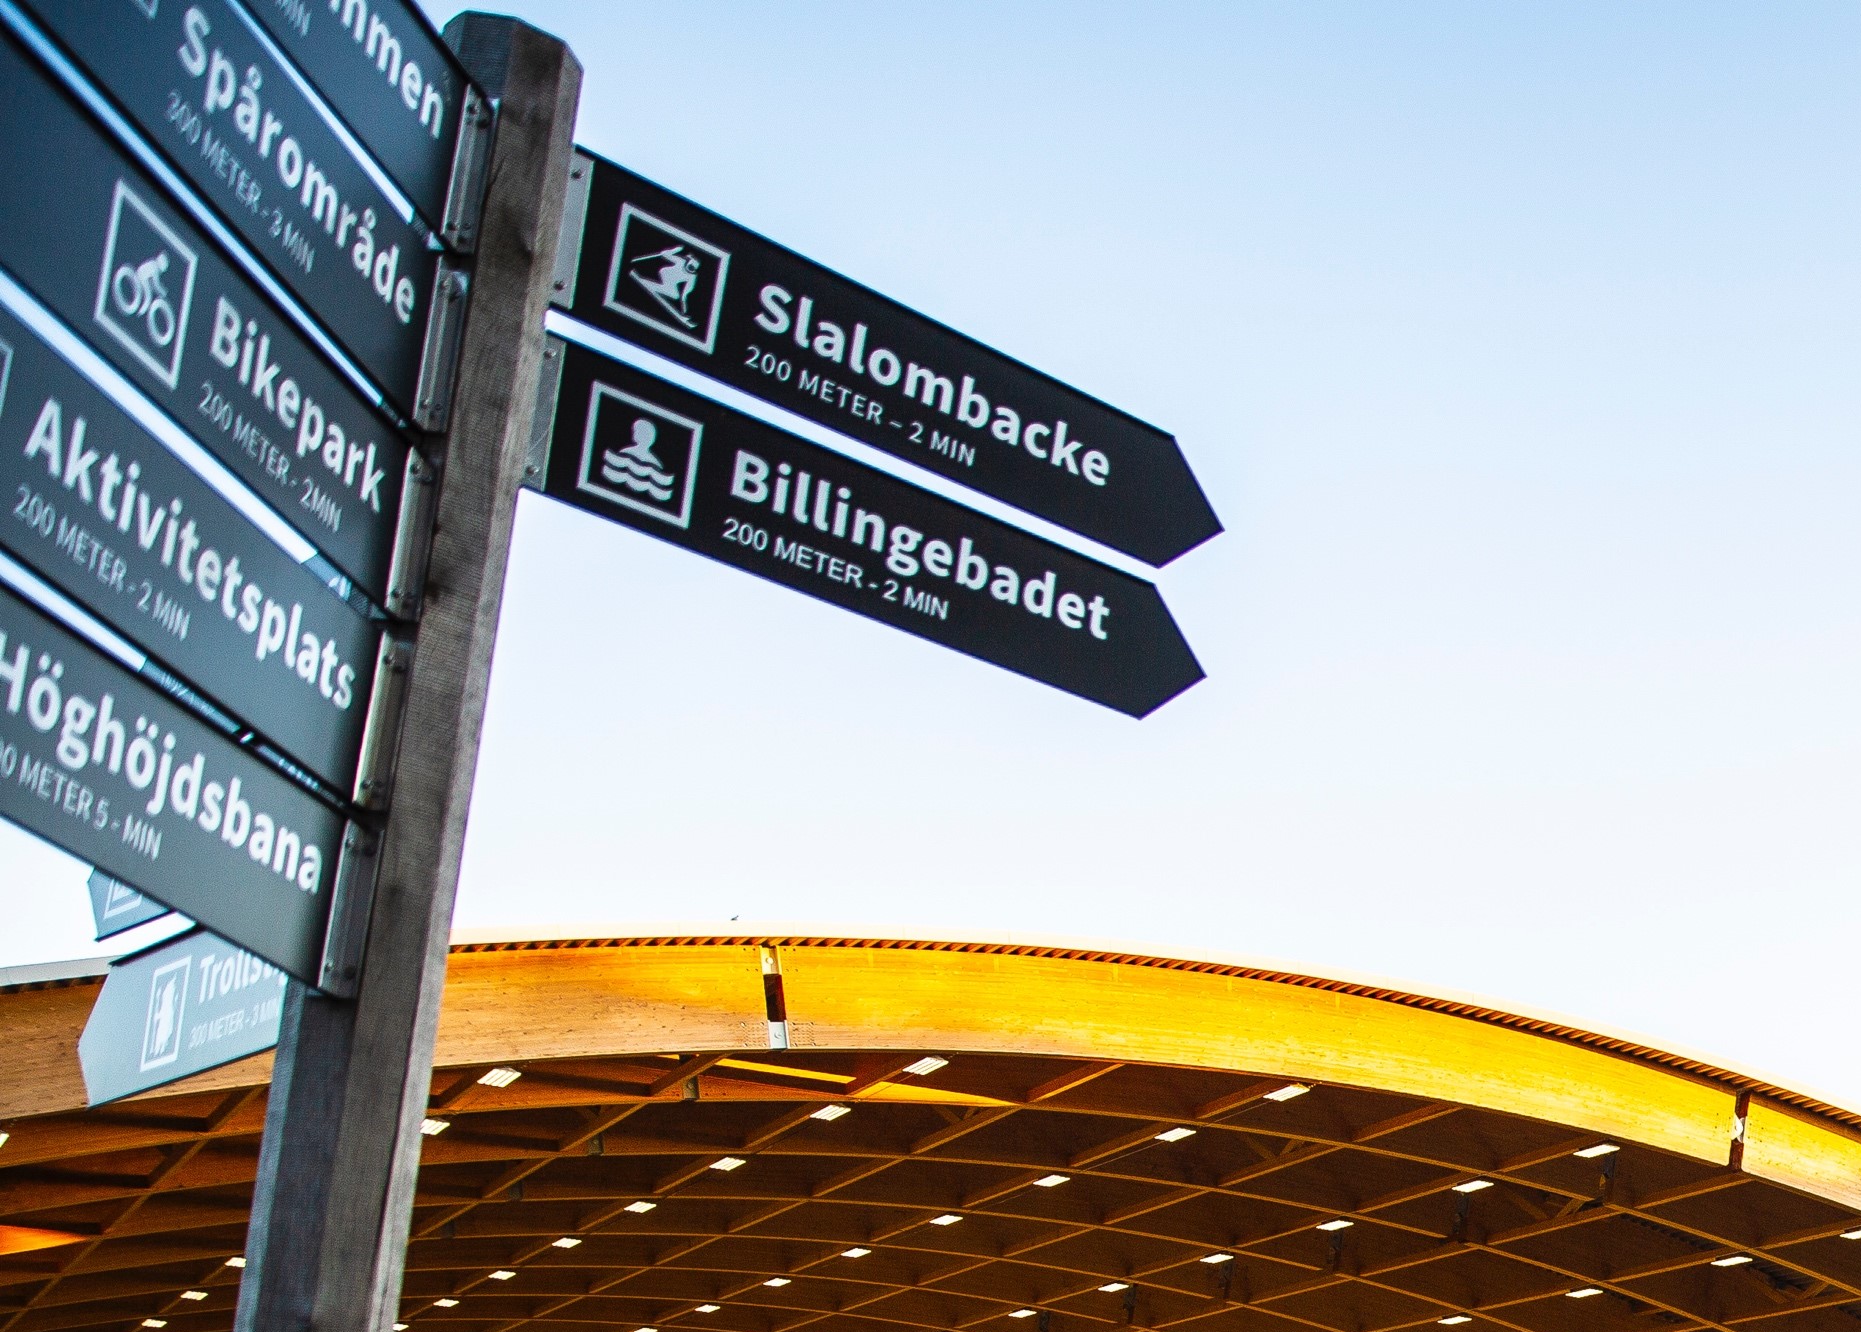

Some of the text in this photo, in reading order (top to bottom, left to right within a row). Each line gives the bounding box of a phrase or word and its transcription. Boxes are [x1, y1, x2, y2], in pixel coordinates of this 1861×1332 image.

[327, 0, 443, 139] mmen
[177, 6, 417, 324] Spårområde
[200, 128, 262, 214] METER
[282, 220, 315, 274] MIN
[198, 381, 233, 432] 200
[232, 415, 291, 487] METER
[209, 295, 385, 514] Bikepark
[744, 345, 791, 381] 200
[798, 369, 883, 425] METER
[907, 422, 923, 444] 2
[929, 430, 975, 467] MIN
[754, 282, 1110, 486] Slalombacke
[12, 484, 55, 537] 200
[56, 515, 127, 593] METER
[137, 580, 152, 612] 2
[152, 591, 191, 641] MIN
[24, 397, 356, 711] Aktivitetsplats
[721, 518, 769, 552] 200
[773, 536, 864, 589] METER
[881, 580, 897, 602] 2
[902, 585, 949, 620] MIN
[730, 448, 1111, 640] Billingebadet
[0, 630, 323, 895] Höghöjdsbana
[0, 736, 17, 779] 0
[18, 752, 94, 824] METER
[94, 795, 110, 830] 5
[122, 814, 162, 861] MIN
[208, 1009, 244, 1040] METER
